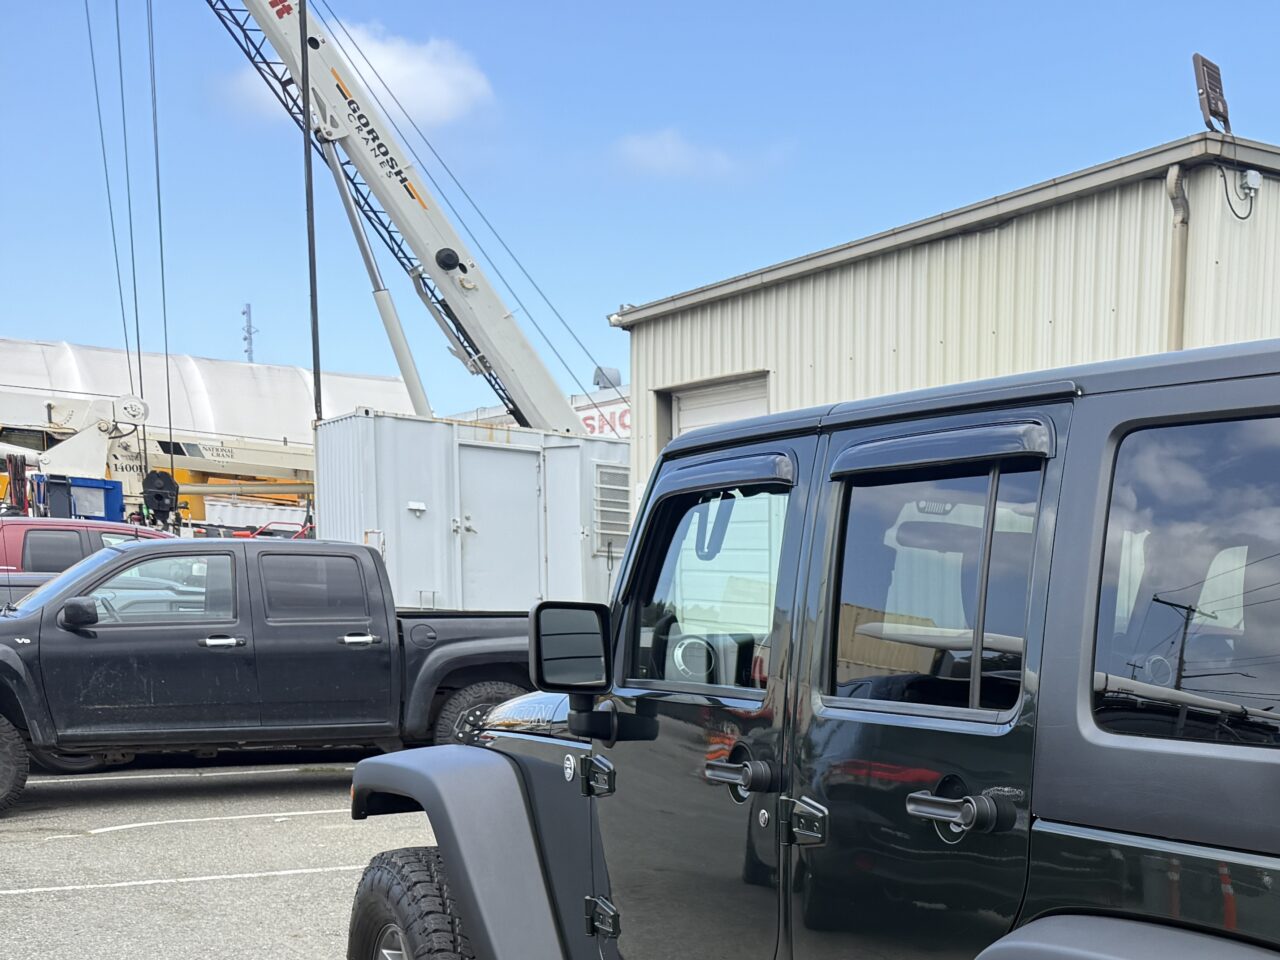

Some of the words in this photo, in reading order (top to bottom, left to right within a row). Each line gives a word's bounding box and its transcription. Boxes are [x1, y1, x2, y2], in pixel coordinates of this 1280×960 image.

[347, 99, 409, 184] GOROSH
[347, 112, 394, 179] CRANES
[202, 446, 235, 454] NATIONAL
